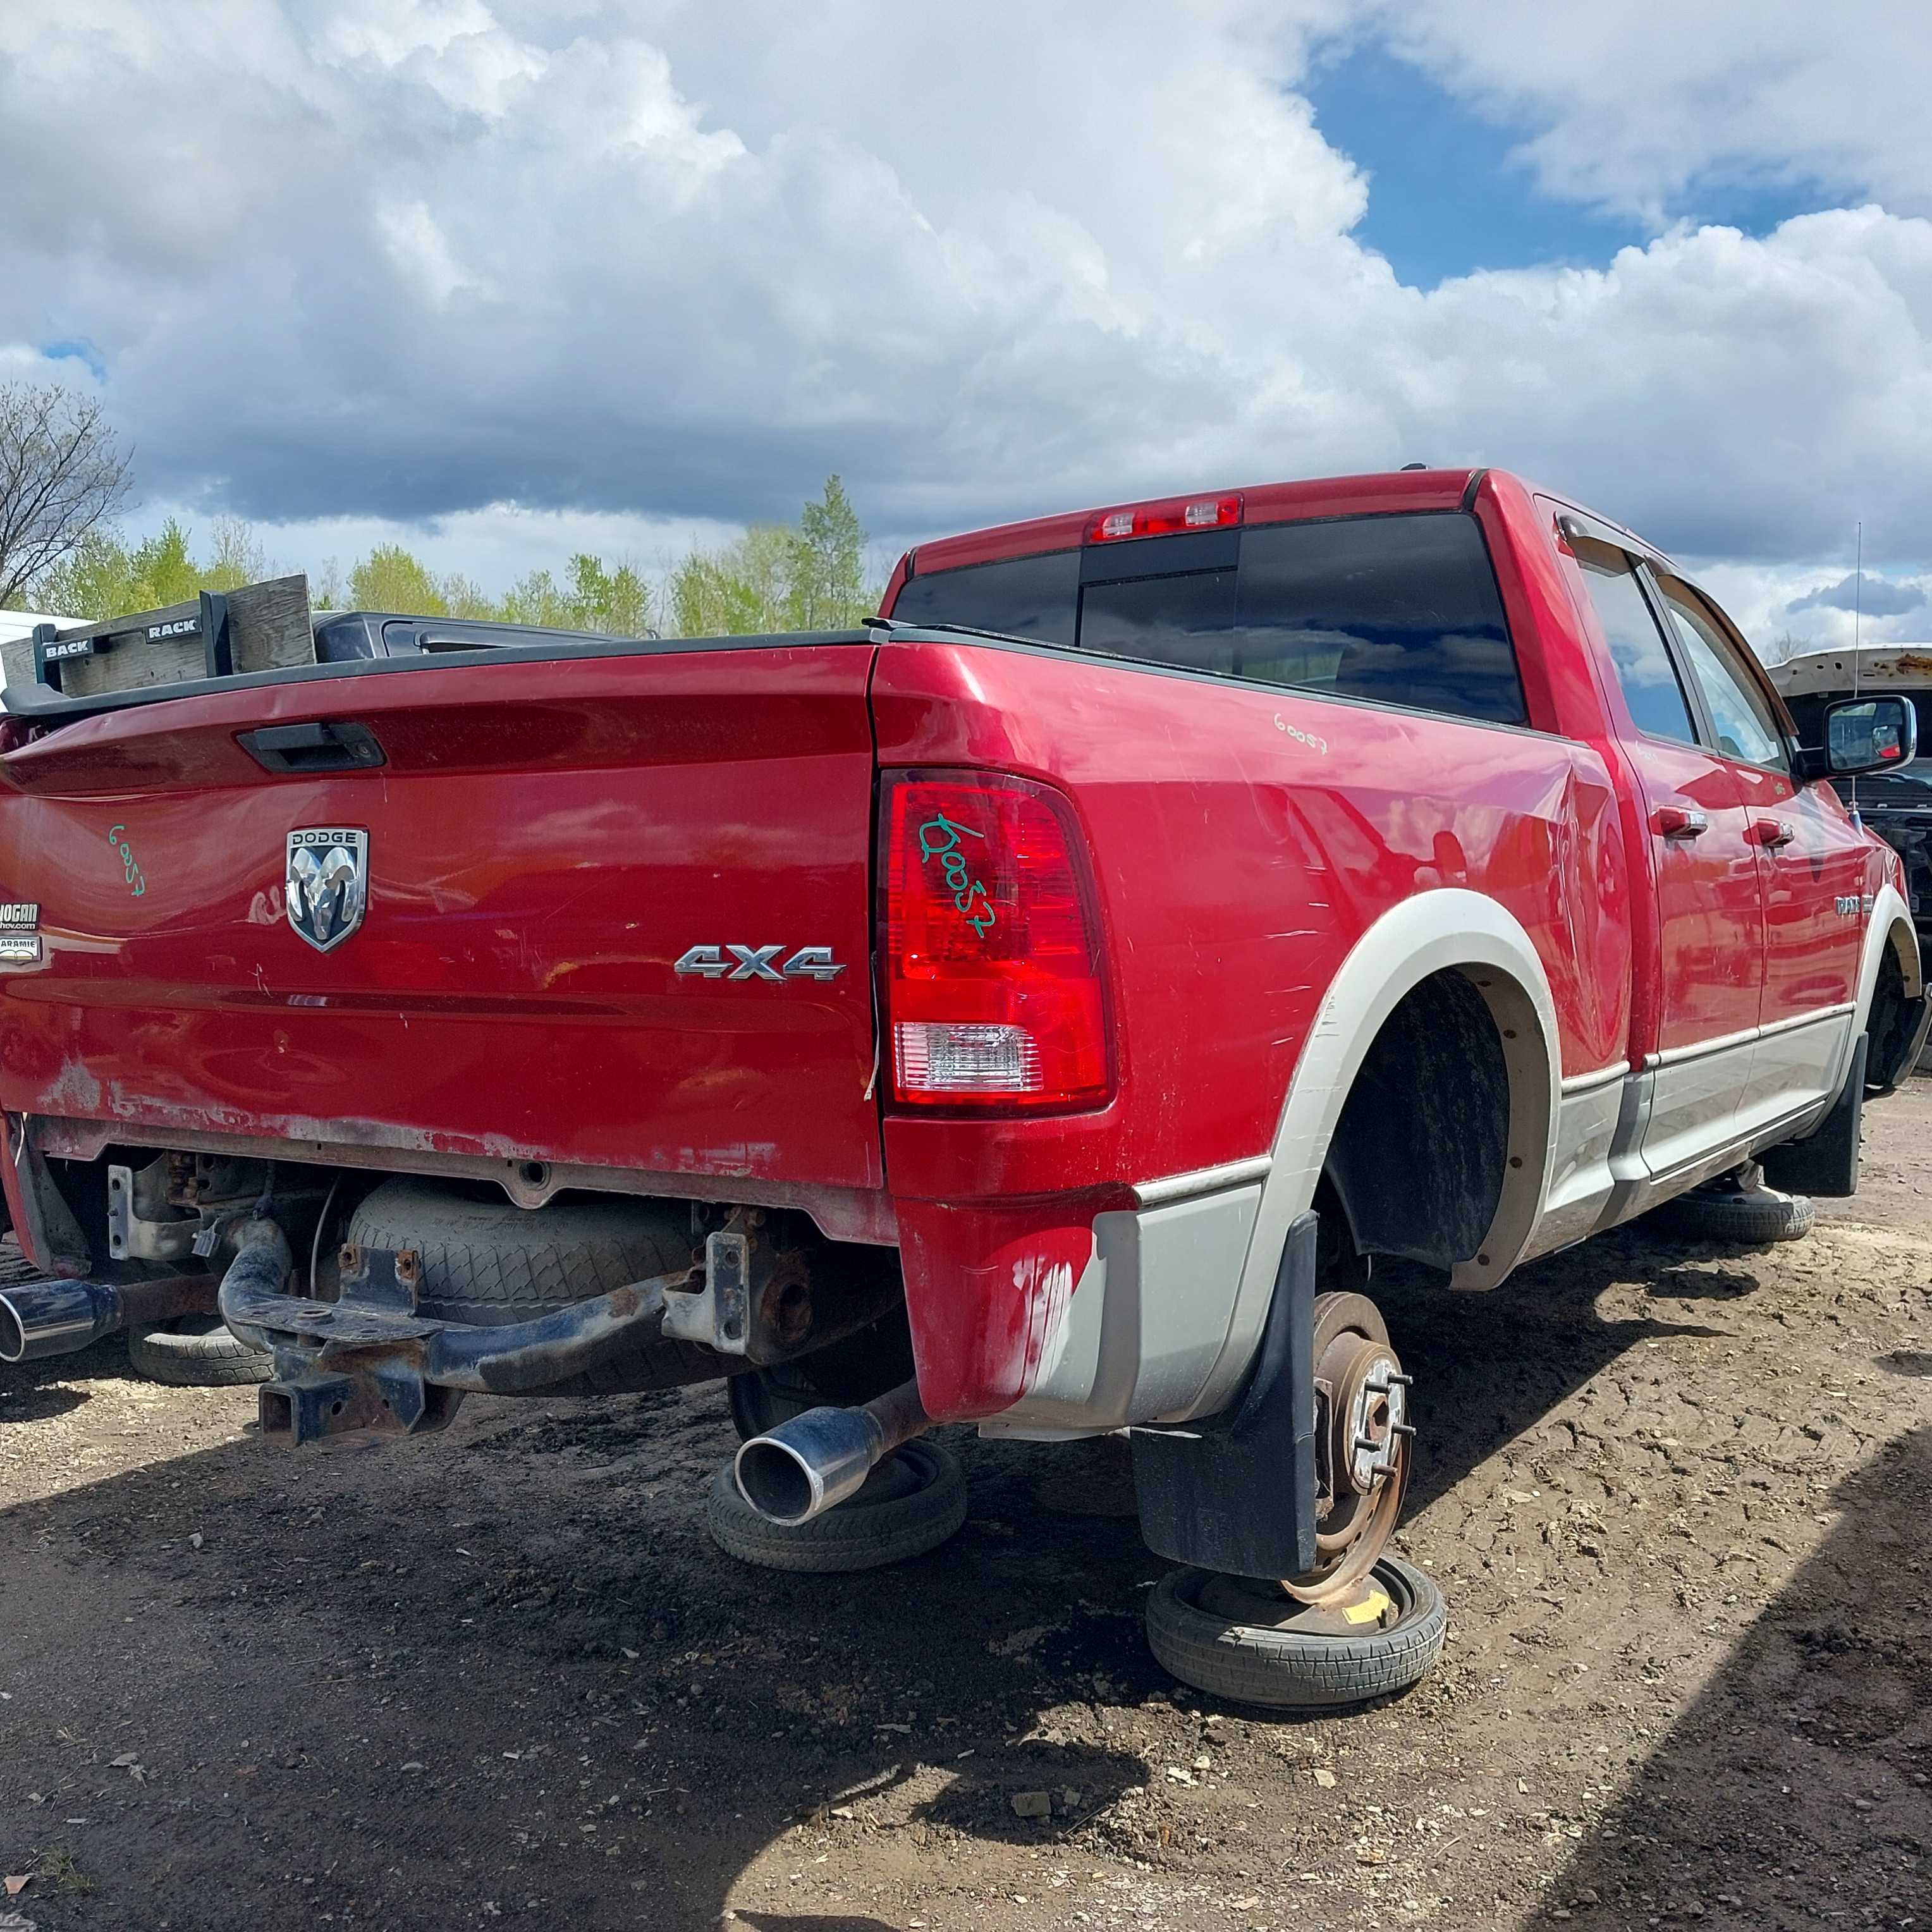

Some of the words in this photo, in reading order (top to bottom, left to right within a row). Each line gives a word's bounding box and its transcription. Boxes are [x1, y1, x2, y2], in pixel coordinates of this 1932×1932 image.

[46, 640, 89, 658] BACK
[149, 619, 197, 639] RACK
[1274, 712, 1328, 755] 60057
[292, 831, 357, 845] DODGE
[673, 945, 848, 981] 4X4
